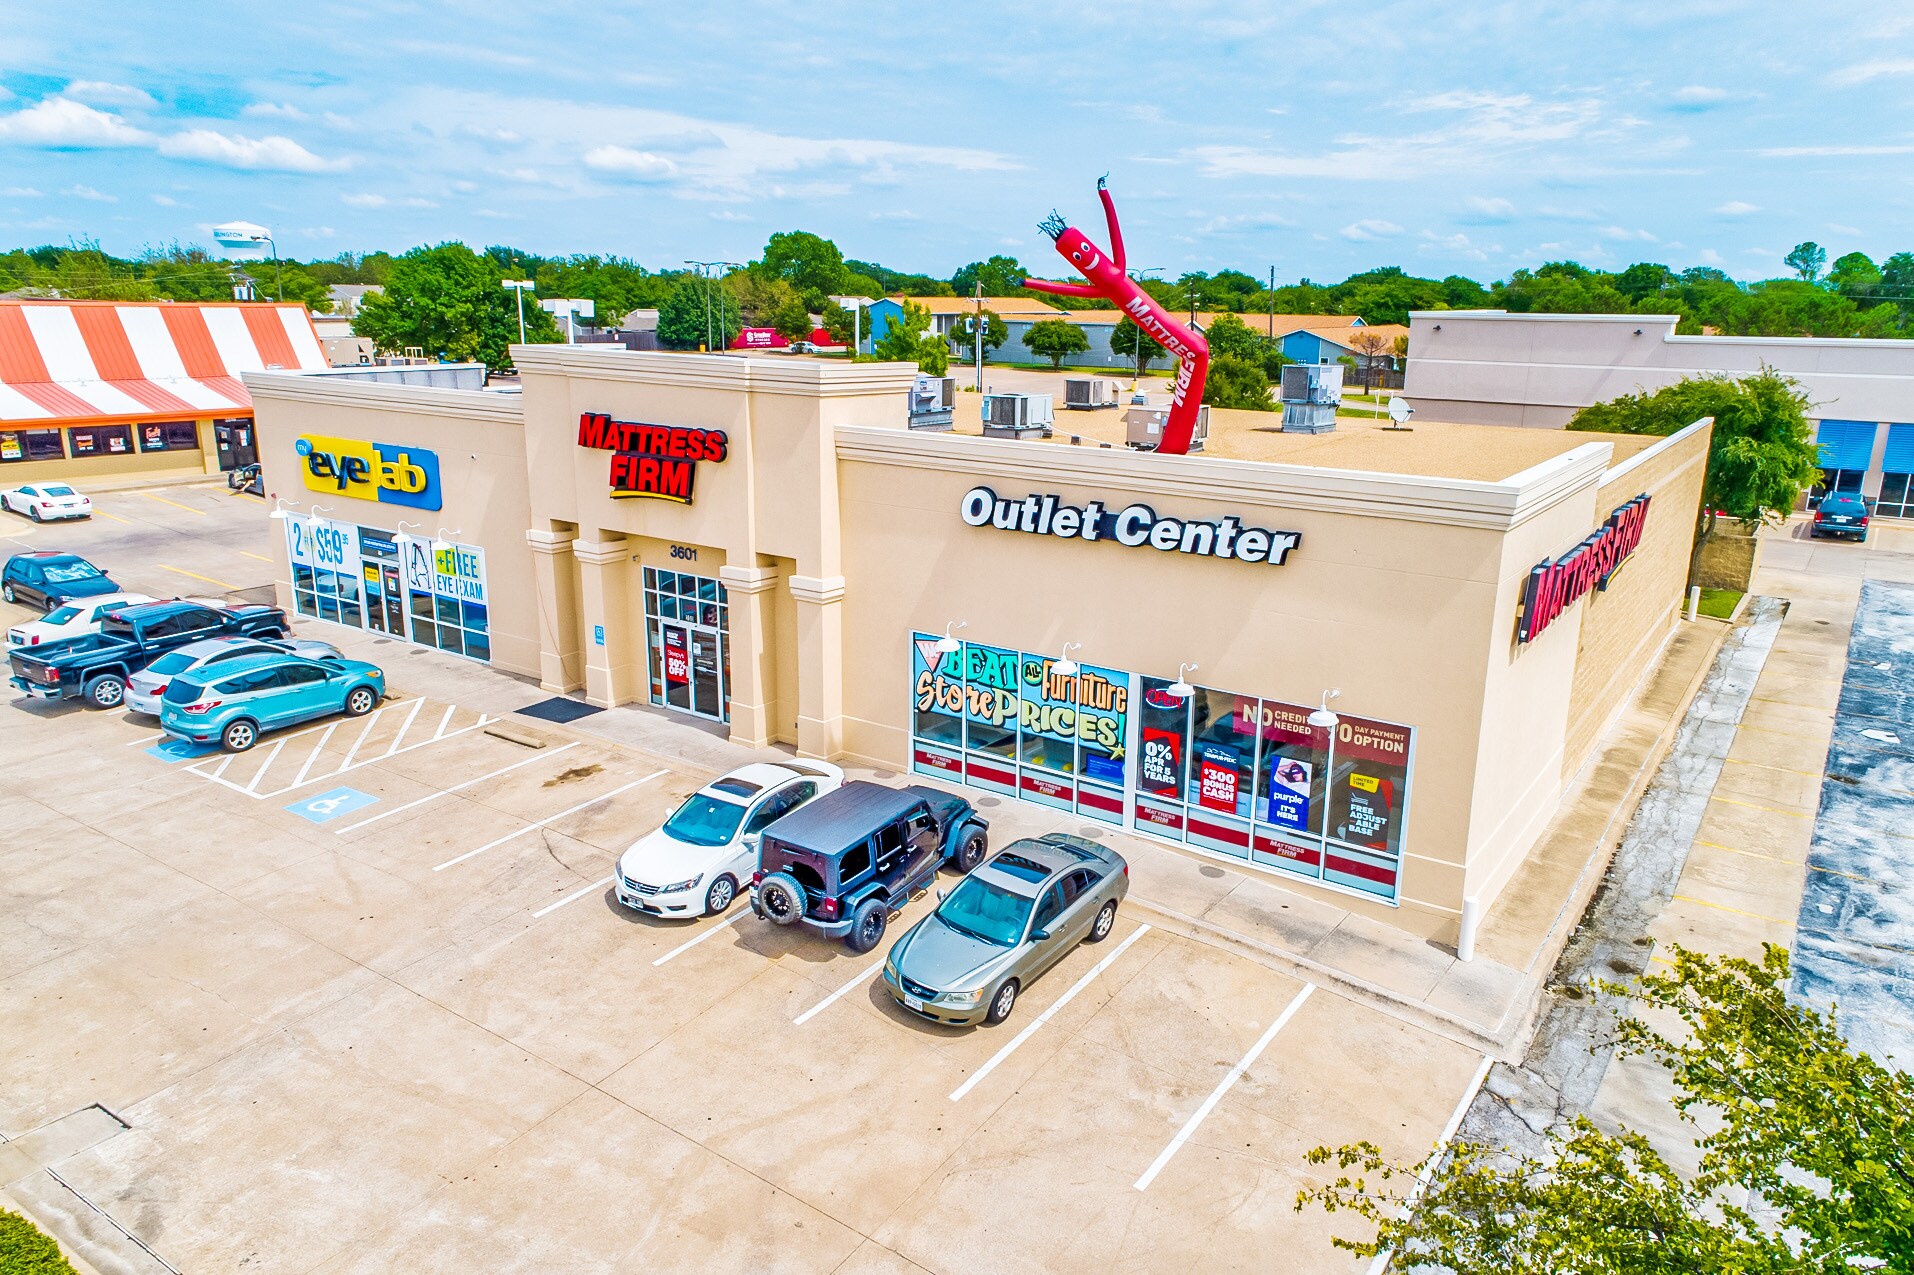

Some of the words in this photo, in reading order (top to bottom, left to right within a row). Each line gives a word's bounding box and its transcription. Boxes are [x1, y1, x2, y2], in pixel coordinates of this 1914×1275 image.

[578, 412, 728, 463] MATTRESS
[609, 453, 696, 498] FIRM
[960, 486, 1106, 543] Outlet
[1115, 503, 1302, 566] Center
[293, 522, 304, 557] 2
[669, 544, 698, 562] 3601
[437, 574, 454, 594] EYE
[455, 578, 484, 601] EXAM
[668, 657, 687, 670] 50%
[941, 646, 1018, 691] BEAT
[1025, 664, 1041, 679] ALL
[668, 666, 685, 677] OFF
[1145, 688, 1182, 709] OPEN
[1242, 704, 1273, 727] NO
[1274, 720, 1312, 735] NEEDED
[1354, 725, 1370, 734] DAY
[1370, 728, 1406, 741] PAYMENT
[1145, 741, 1173, 761] 0%
[1353, 734, 1404, 754] OPTION
[926, 753, 952, 764] MATTRESS
[931, 759, 947, 768] FIRM
[1144, 756, 1165, 767] APR
[1144, 763, 1164, 774] FOR
[1164, 767, 1171, 776] 5
[1203, 767, 1236, 785] $300
[1143, 770, 1177, 785] YEARS
[1033, 779, 1062, 792] MATTRESS
[1039, 786, 1056, 795] FIRM
[1203, 778, 1235, 792] BONUS
[1202, 786, 1235, 802] CASH
[1273, 791, 1304, 805] purple
[1144, 807, 1176, 820] MATTRESS
[1276, 810, 1299, 822] HERE
[1280, 804, 1296, 814] IT'S
[1350, 804, 1374, 815] FREE
[1150, 815, 1169, 824] FIRM
[1349, 810, 1388, 825] ADJUST
[1348, 824, 1374, 837] BASE
[1269, 840, 1305, 854] MATTRESS
[1276, 848, 1297, 858] FIRM
